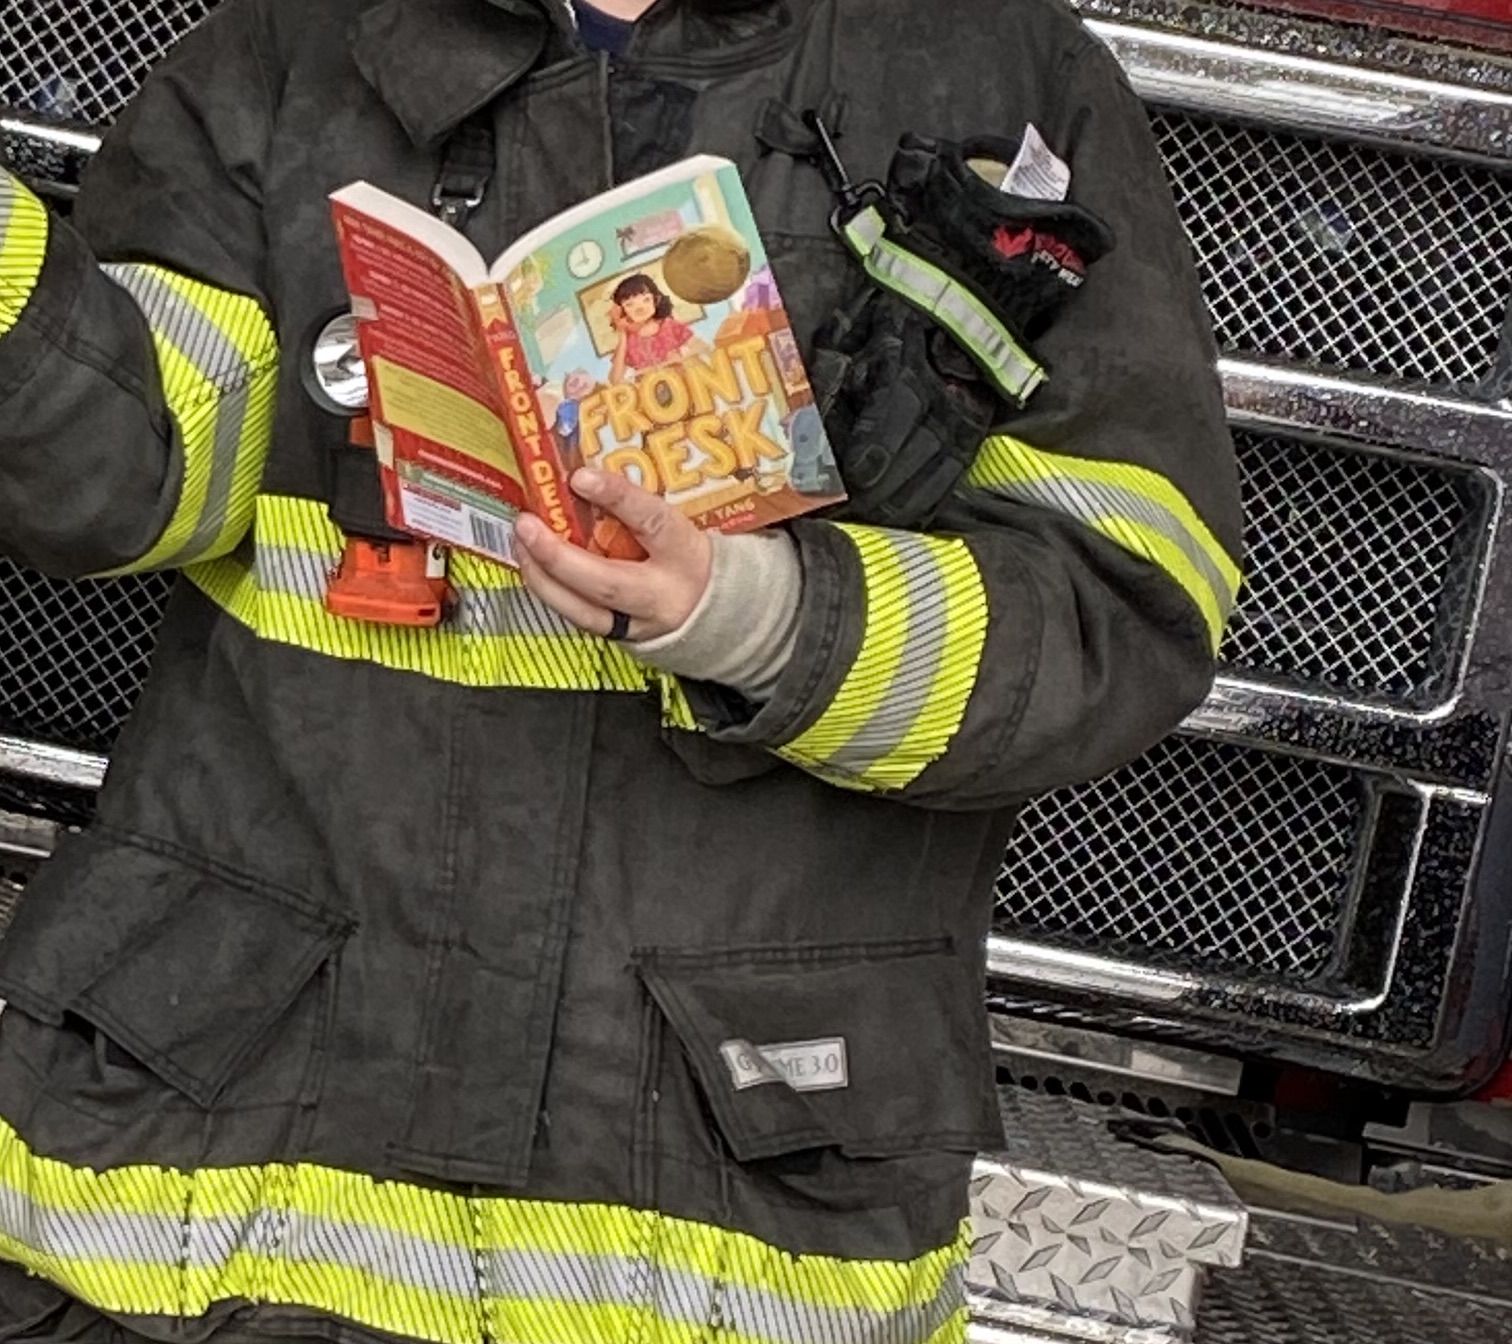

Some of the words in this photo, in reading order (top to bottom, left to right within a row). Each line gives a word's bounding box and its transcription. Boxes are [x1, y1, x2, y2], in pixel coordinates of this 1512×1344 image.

[498, 346, 543, 457] FRONT
[577, 334, 772, 459] FRONT
[603, 398, 788, 495] DESK
[714, 497, 756, 520] YANG
